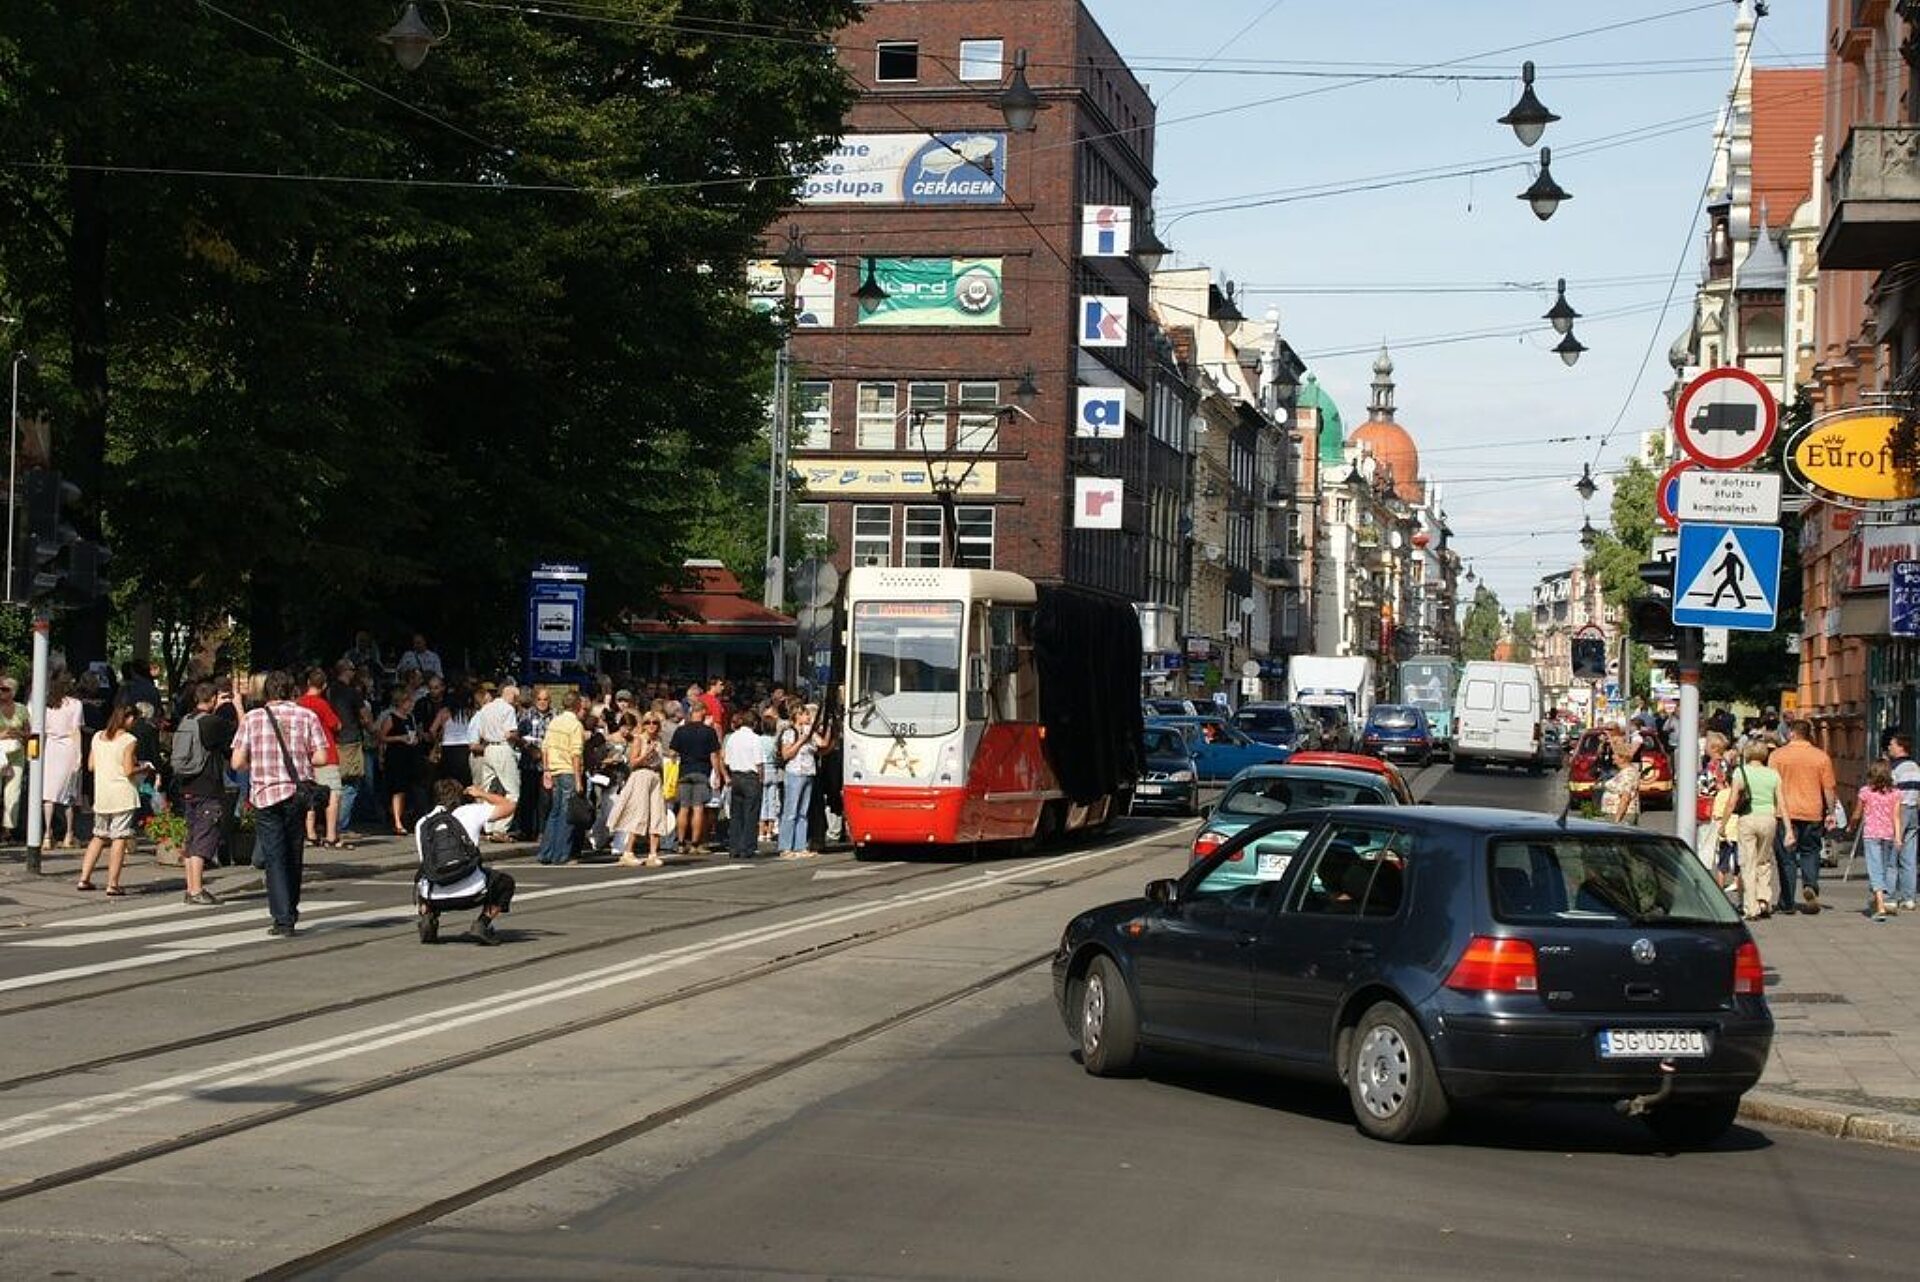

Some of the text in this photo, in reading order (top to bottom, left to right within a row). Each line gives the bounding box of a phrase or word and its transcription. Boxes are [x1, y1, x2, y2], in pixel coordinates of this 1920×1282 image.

[912, 180, 996, 195] CERAGEM
[890, 722, 917, 736] 786
[1612, 1029, 1639, 1050] SG
